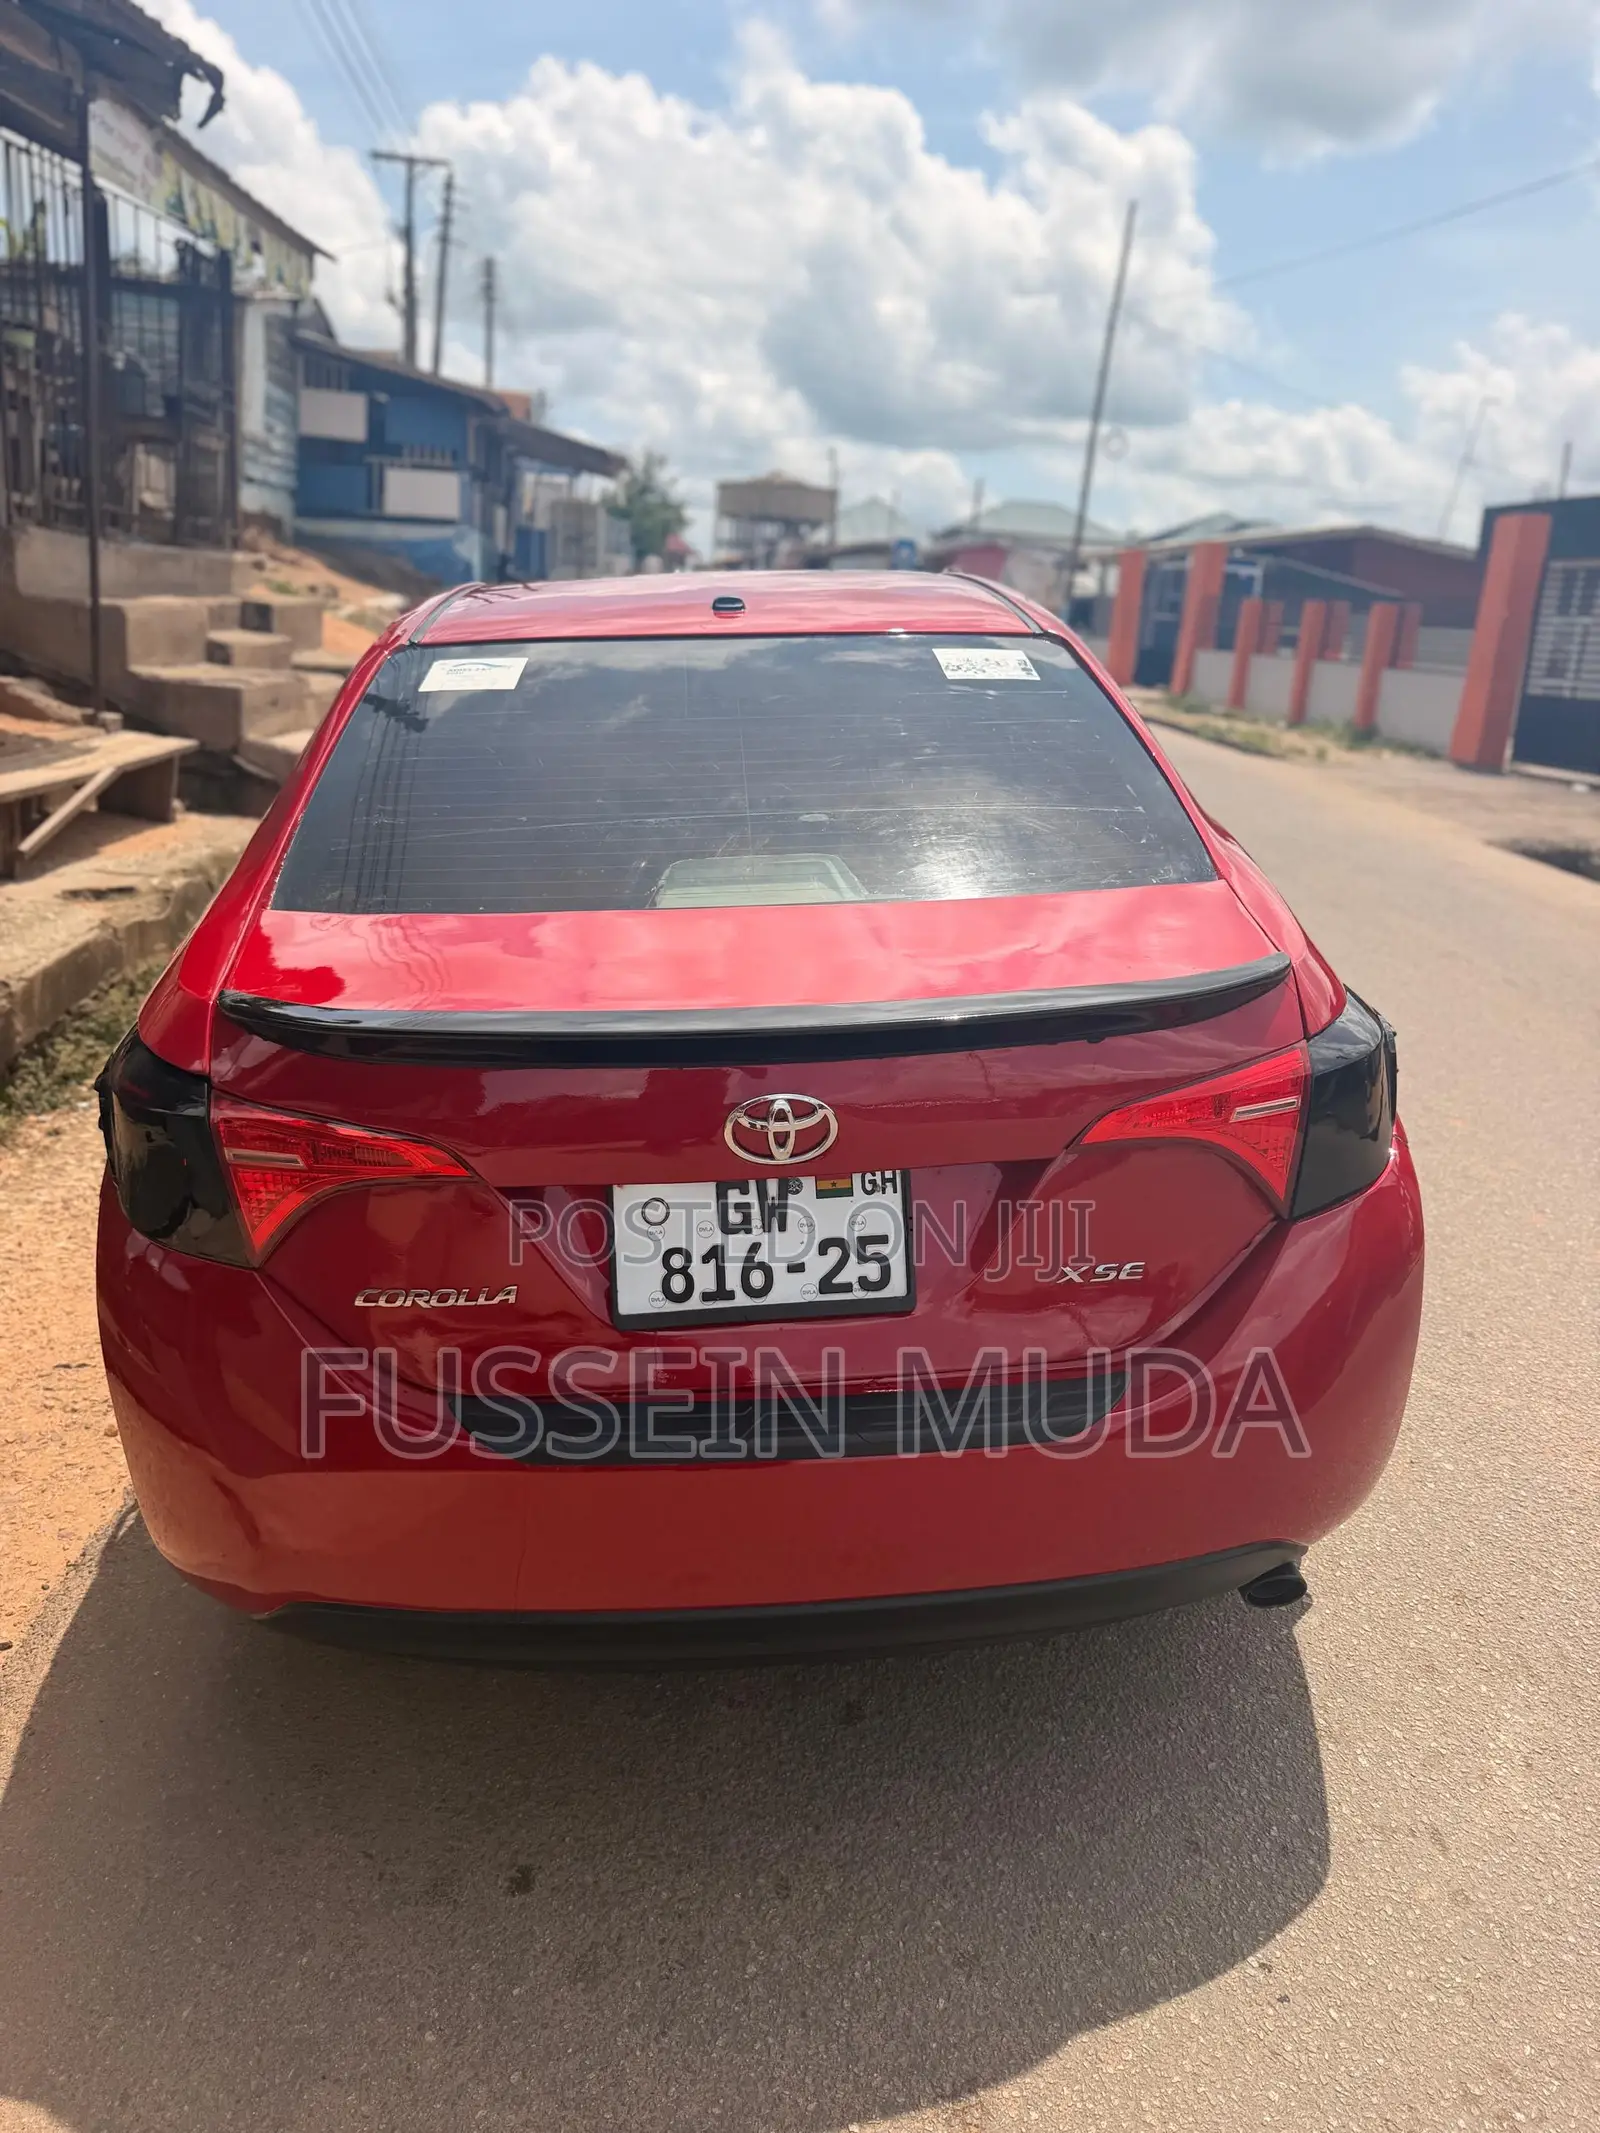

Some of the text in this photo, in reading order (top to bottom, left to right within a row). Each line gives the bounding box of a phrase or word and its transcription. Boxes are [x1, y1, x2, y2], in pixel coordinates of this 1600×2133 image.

[861, 1171, 898, 1196] GH
[715, 1178, 789, 1235] GW
[661, 1234, 892, 1304] 816-25
[1056, 1262, 1146, 1284] XSE
[354, 1285, 518, 1309] COROLLA
